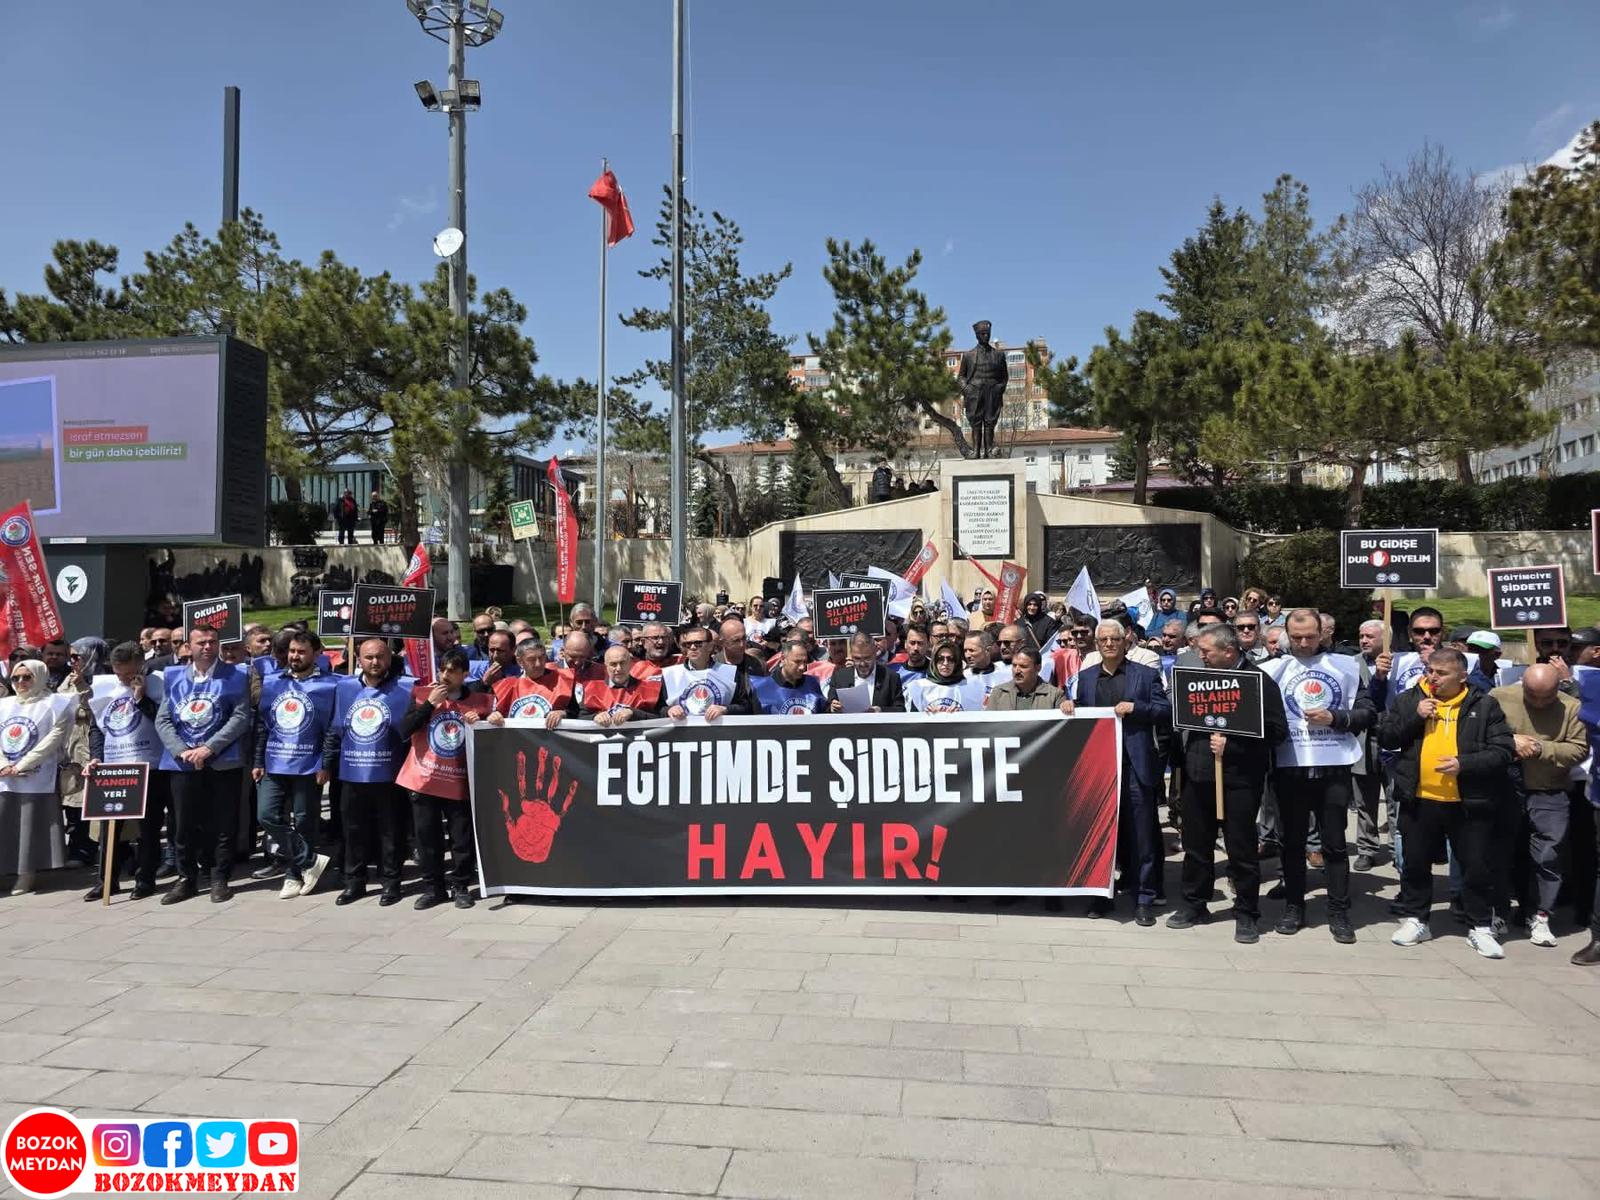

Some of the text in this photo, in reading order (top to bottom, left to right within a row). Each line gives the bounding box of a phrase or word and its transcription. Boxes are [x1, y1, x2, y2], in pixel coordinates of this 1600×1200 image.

[69, 448, 83, 458] bir
[86, 447, 105, 460] gün
[107, 447, 134, 457] daha
[1360, 539, 1418, 550] BU GİDİŞE
[1348, 554, 1431, 564] DUR DİYELİM
[1497, 572, 1552, 581] EĞİTİMCİYE
[634, 585, 668, 594] NEREYE
[1501, 582, 1551, 593] ŞİDDETE
[333, 597, 344, 605] BU
[369, 594, 416, 604] OKULDA
[643, 593, 657, 601] BU
[826, 594, 867, 609] OKULDA
[1501, 596, 1553, 607] HAYIR
[194, 602, 228, 619] OKULDA
[636, 602, 662, 612] GİDİŞ
[846, 612, 865, 623] NE?
[1188, 679, 1240, 691] OKULDA
[1188, 689, 1241, 703] SİLAHIN
[1192, 702, 1237, 716] İŞİ NE?
[96, 768, 140, 776] YÜREĞİMİZ
[597, 735, 1023, 808] EĞİTİMDE ŞİDDETE
[95, 777, 138, 787] YANGIN
[103, 789, 127, 798] YERİ
[687, 823, 948, 882] HAYIR!
